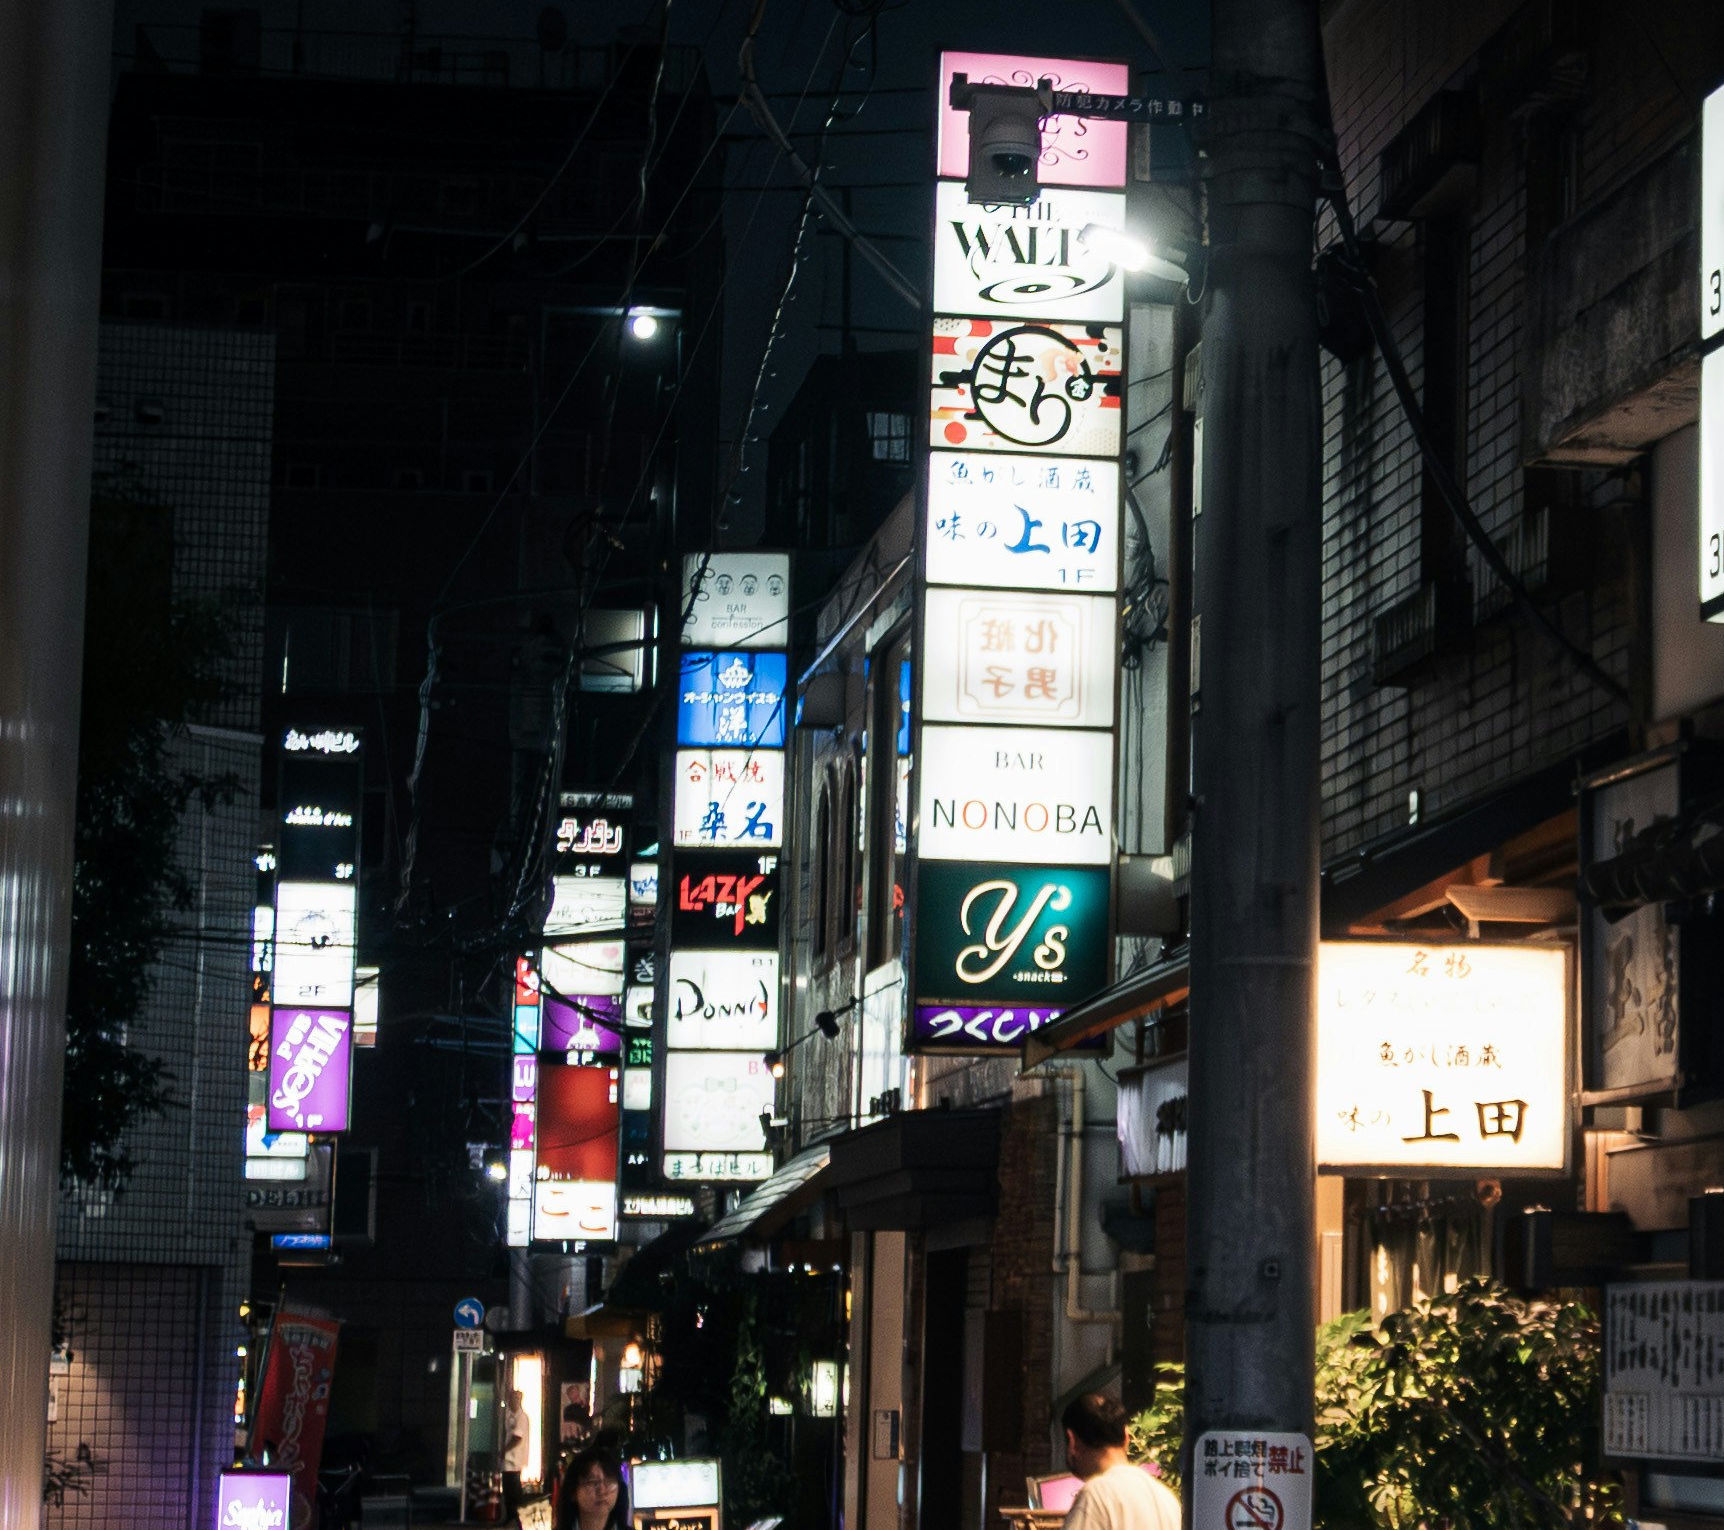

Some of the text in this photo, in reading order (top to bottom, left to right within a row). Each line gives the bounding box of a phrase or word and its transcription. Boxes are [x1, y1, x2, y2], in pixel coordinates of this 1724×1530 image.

[949, 220, 1092, 267] WALT
[936, 503, 1103, 555] 味の上田
[1057, 568, 1096, 584] 1F
[727, 604, 747, 614] BAR
[994, 750, 1044, 770] BAR
[699, 801, 774, 840] 桑名
[932, 797, 1104, 836] NONOBA
[574, 864, 601, 877] 3F
[758, 855, 778, 875] 1F
[679, 874, 766, 936] LAZY
[1406, 950, 1472, 979] 名物
[1337, 1088, 1530, 1145] 味の上田
[1268, 1445, 1305, 1475] 禁止
